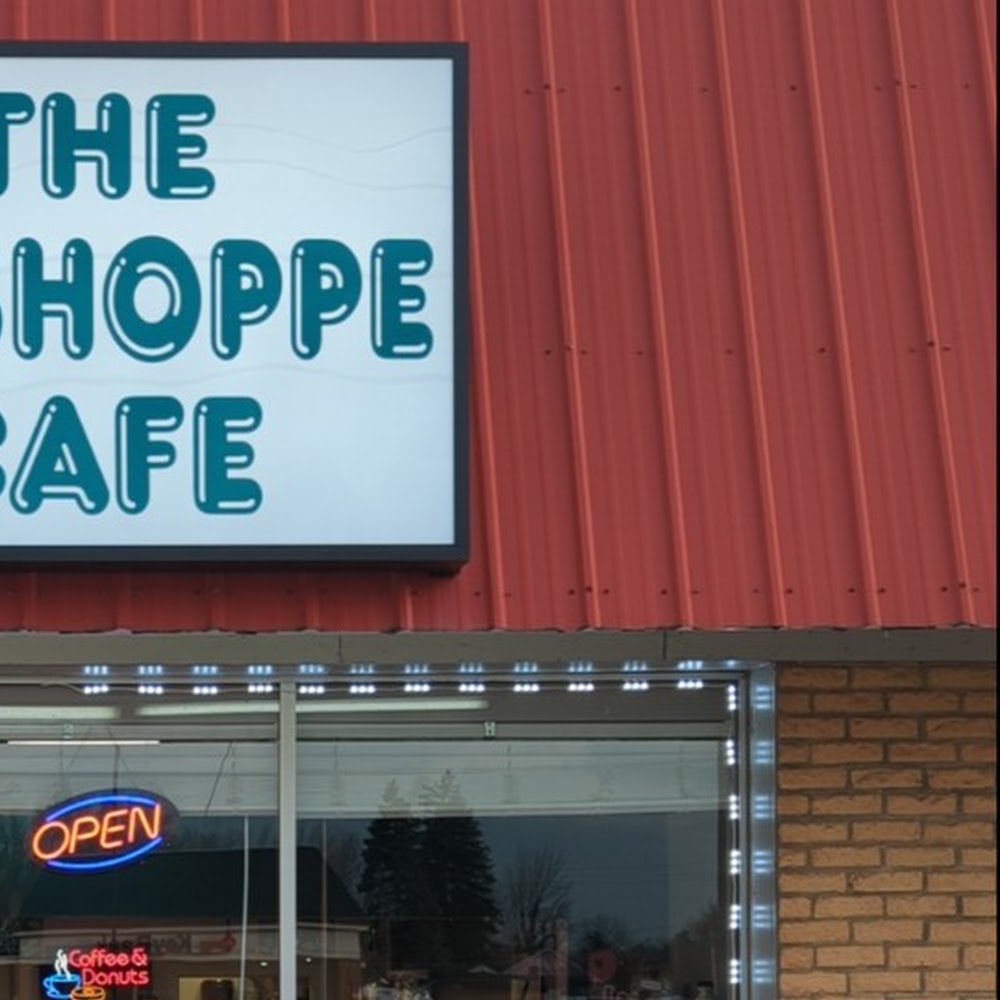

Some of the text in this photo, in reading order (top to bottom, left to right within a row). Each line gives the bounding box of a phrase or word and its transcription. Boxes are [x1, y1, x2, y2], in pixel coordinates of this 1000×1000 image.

[31, 803, 163, 861] OPEN
[68, 947, 149, 968] Coffee &
[81, 967, 150, 986] Donuts
